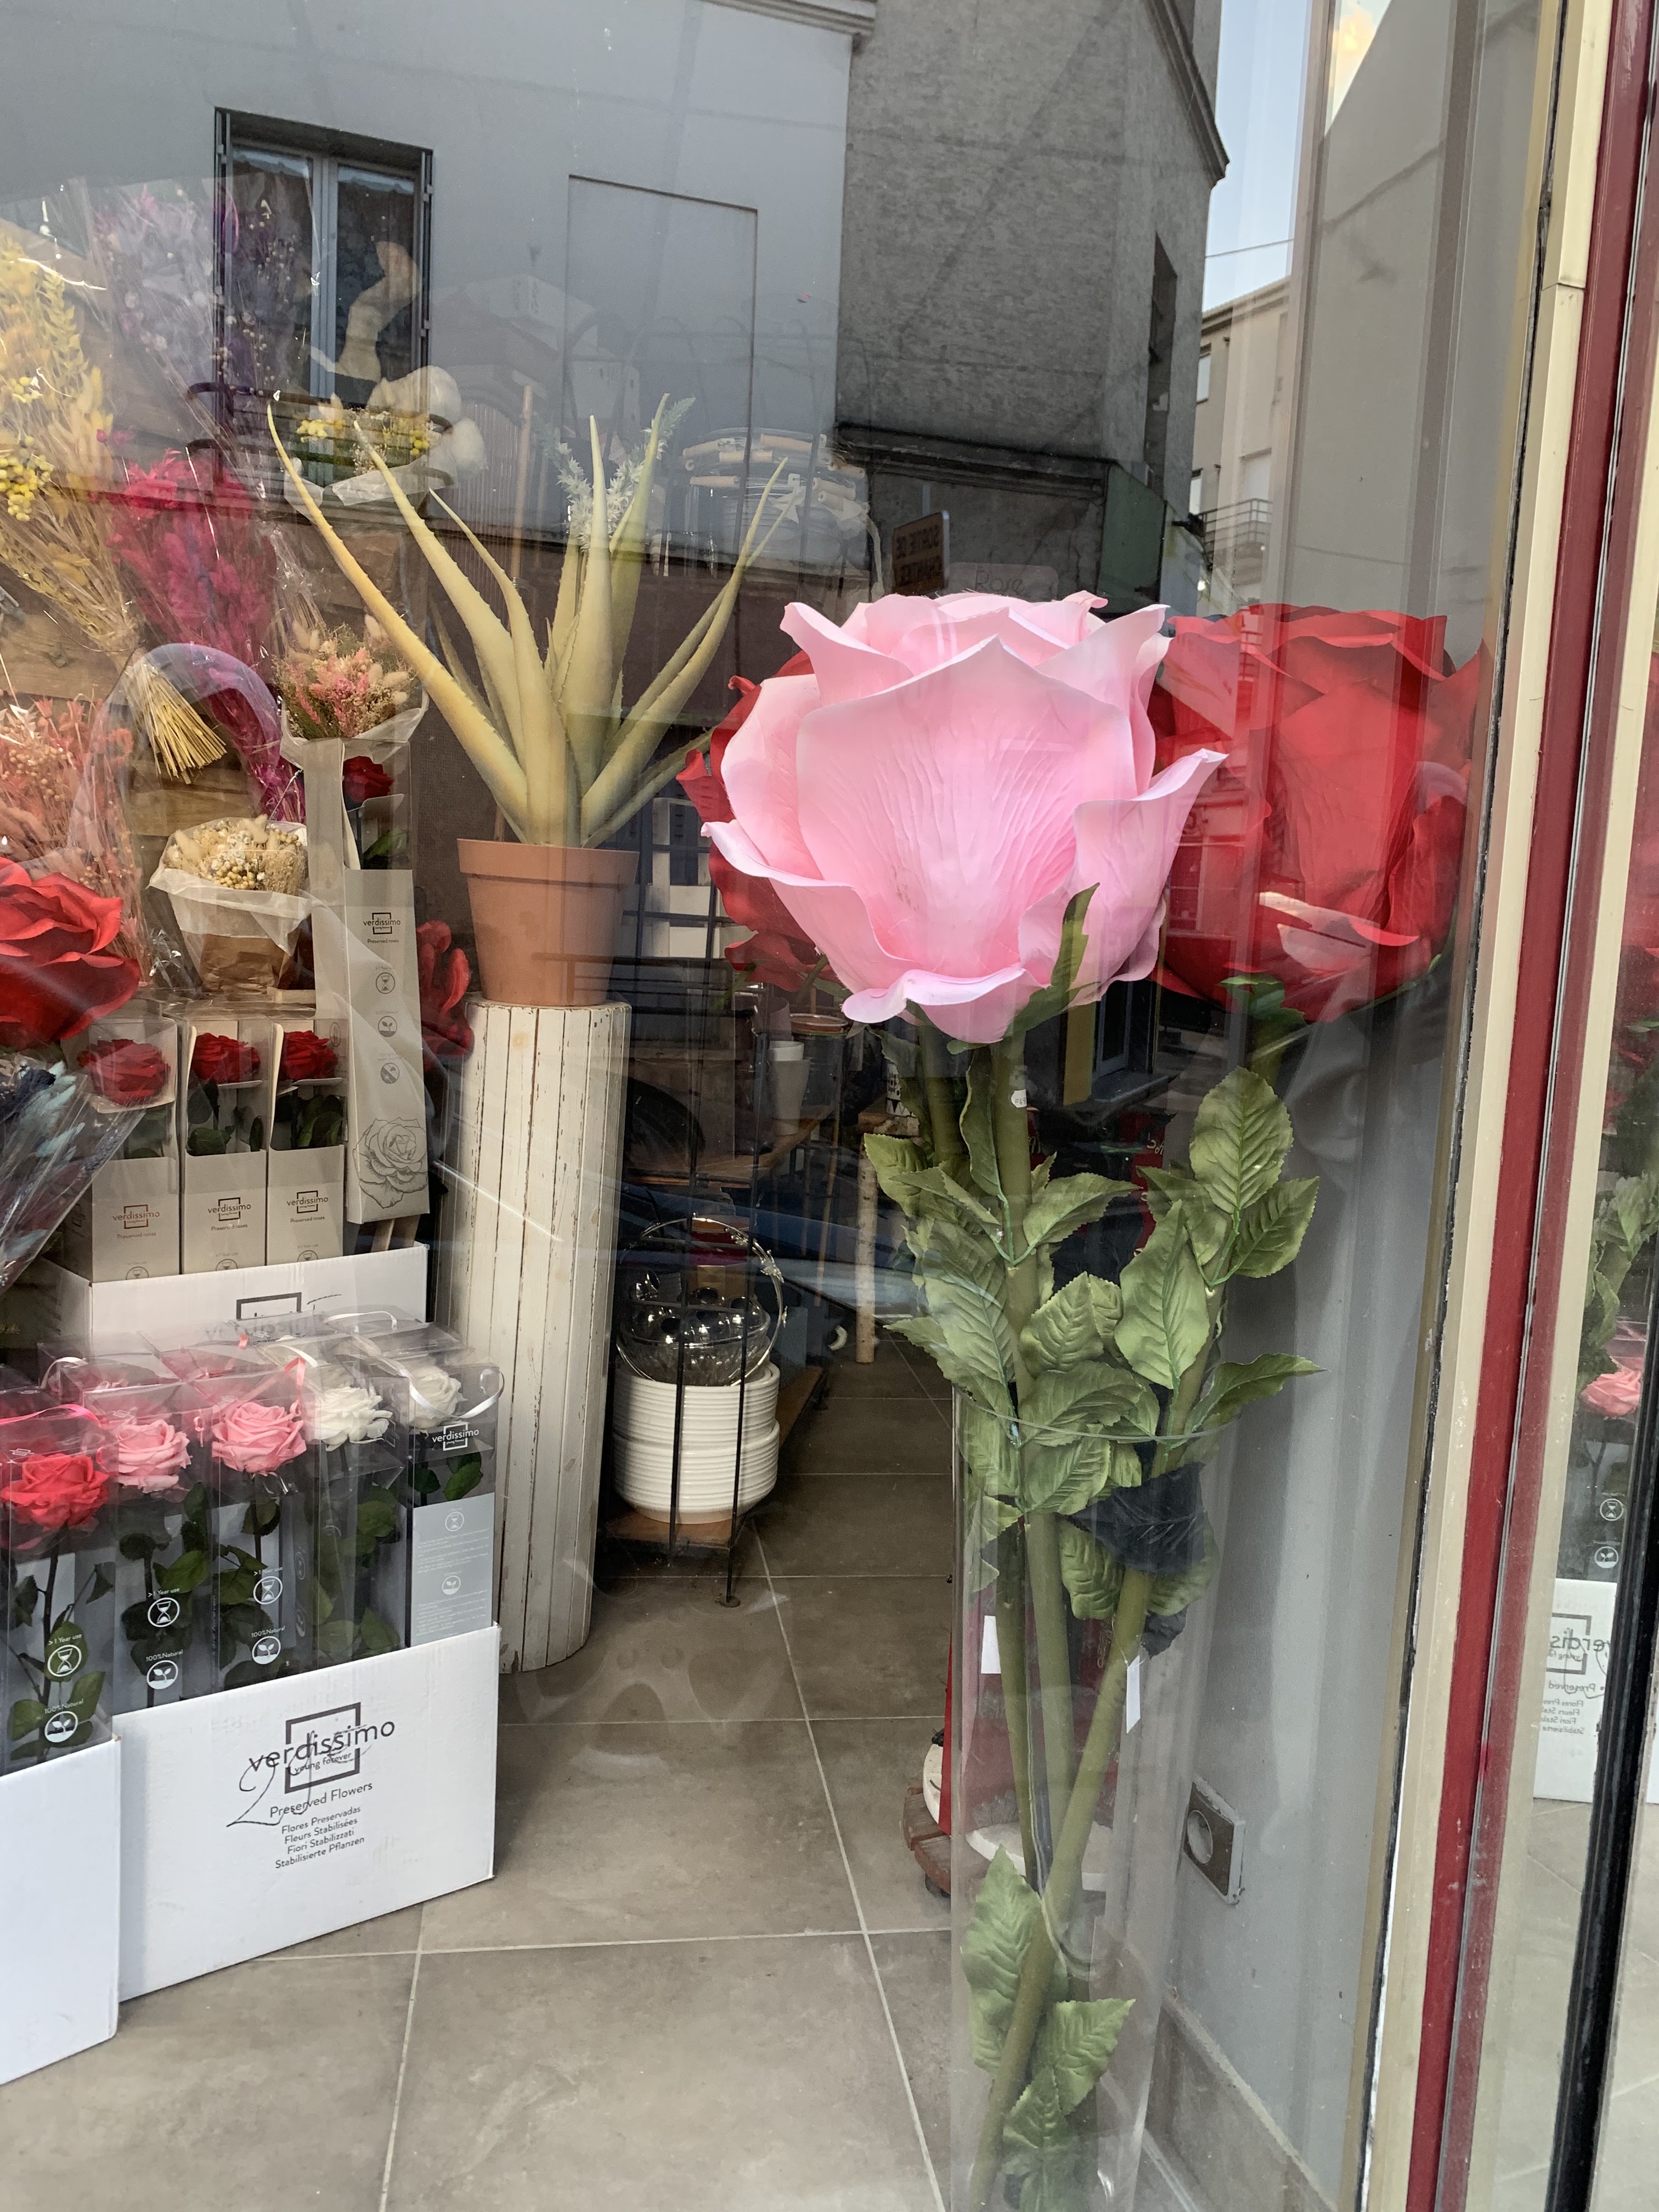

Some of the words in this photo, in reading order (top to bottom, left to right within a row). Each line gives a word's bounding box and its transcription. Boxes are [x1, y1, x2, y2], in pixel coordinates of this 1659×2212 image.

[363, 917, 401, 926] verdissimo
[208, 1204, 251, 1214] verdissimo
[286, 1197, 329, 1206] verdissimo
[112, 1211, 160, 1221] verdissimo
[432, 1429, 479, 1443] verdissimo
[249, 1721, 396, 1772] verdissimo
[295, 1761, 320, 1773] young
[323, 1752, 352, 1765] forever
[270, 1792, 327, 1818] Preserved
[331, 1783, 373, 1801] Flowers
[281, 1822, 308, 1835] Flores
[311, 1807, 361, 1826] Preservadas
[284, 1832, 312, 1844] Fleurs
[314, 1818, 358, 1836] Stabilisées
[287, 1841, 308, 1854] Fiori
[309, 1827, 355, 1848] Stabilizzati
[275, 1849, 326, 1869] Stabilisierte
[329, 1837, 365, 1853] Pflanzen
